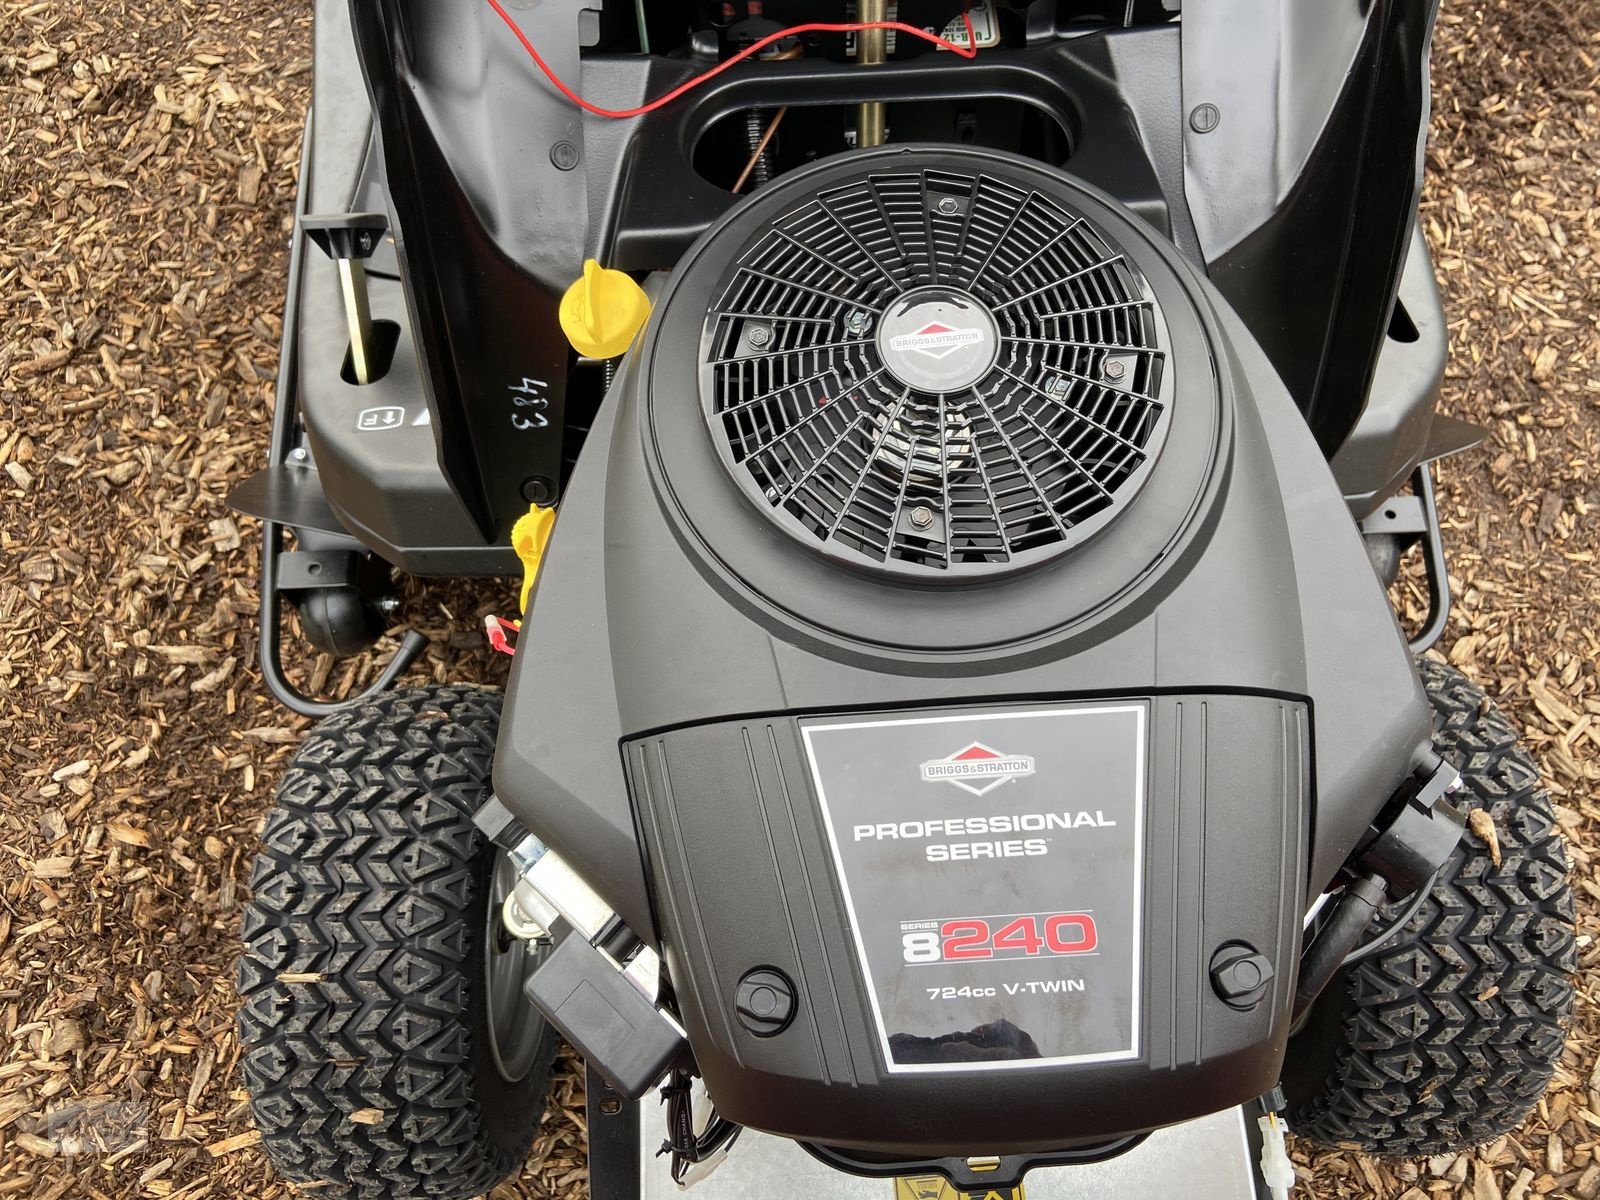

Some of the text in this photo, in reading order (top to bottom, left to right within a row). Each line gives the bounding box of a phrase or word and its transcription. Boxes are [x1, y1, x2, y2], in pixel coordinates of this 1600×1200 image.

[508, 377, 549, 430] 483
[928, 760, 1029, 776] BRIGGS&STRATTON
[854, 810, 1116, 841] PROFESSIONAL
[900, 921, 938, 931] SERIES
[926, 979, 1085, 1000] 724cc V-TWIN
